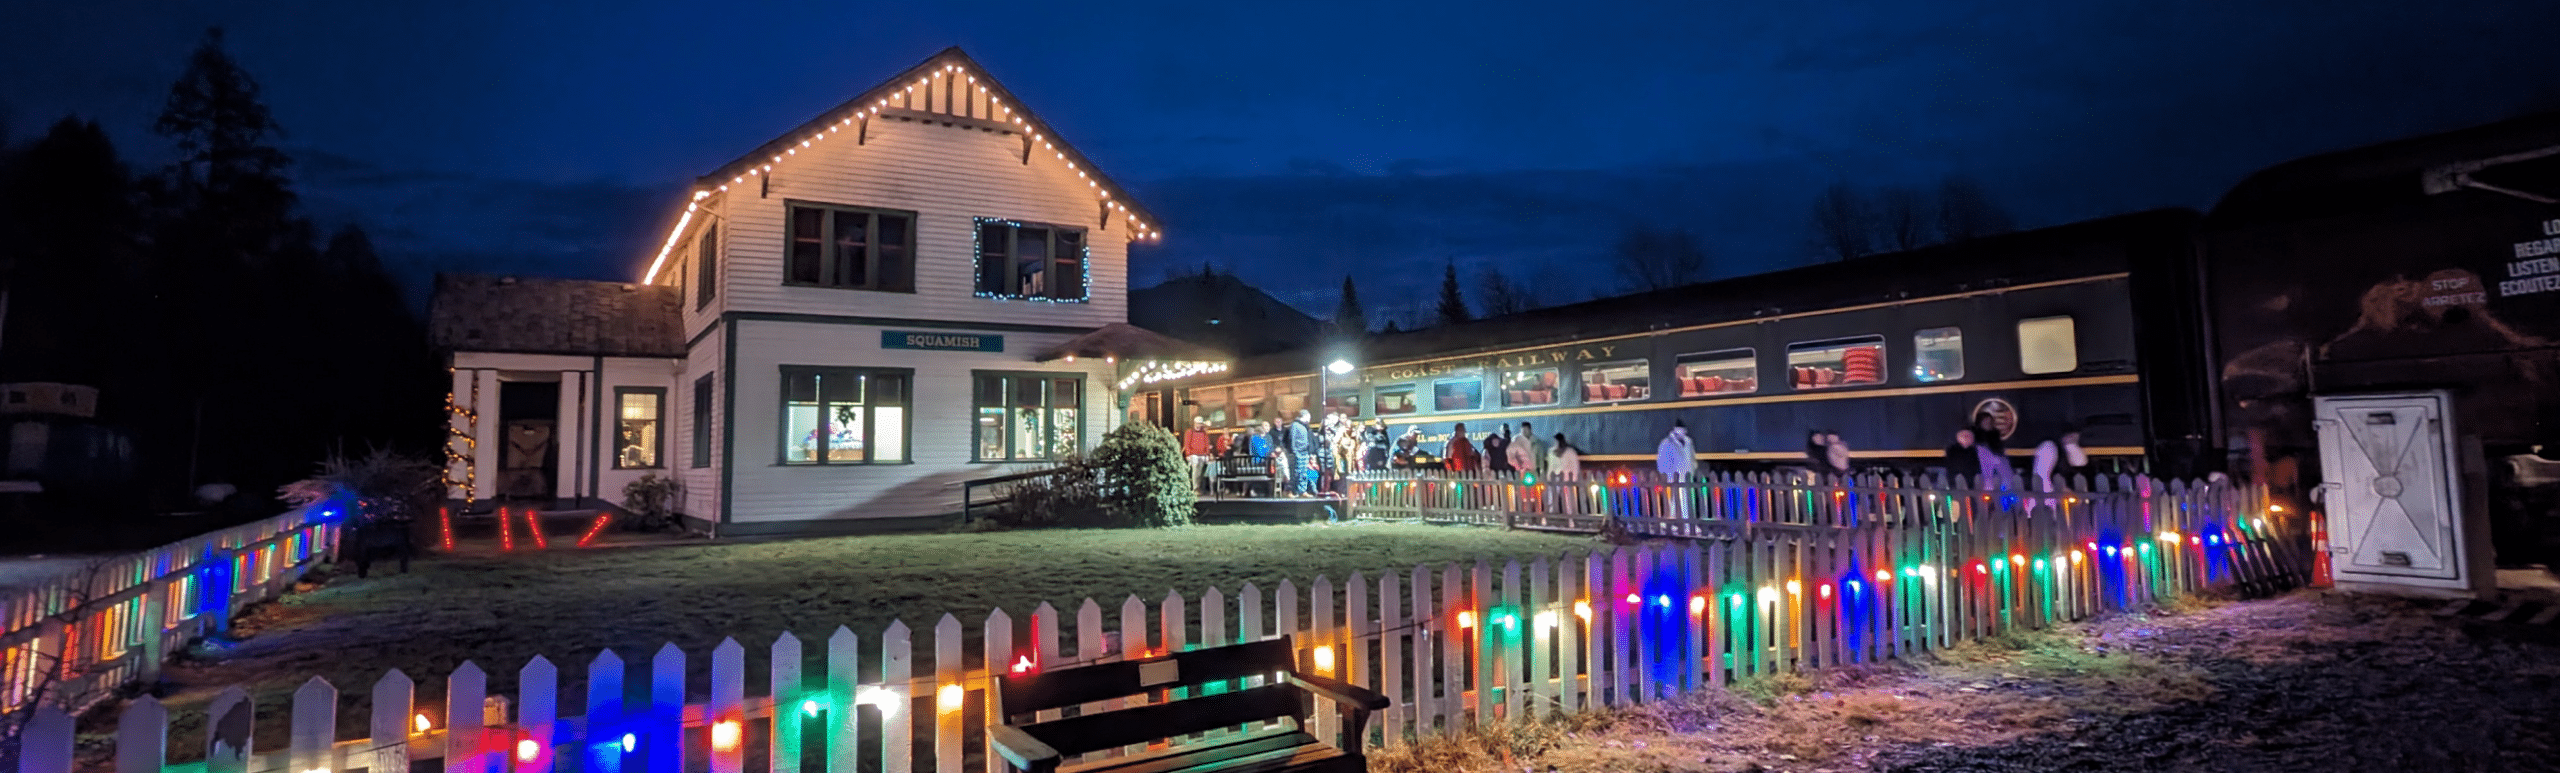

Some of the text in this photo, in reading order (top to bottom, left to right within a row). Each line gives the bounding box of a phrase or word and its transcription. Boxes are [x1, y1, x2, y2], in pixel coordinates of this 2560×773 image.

[2431, 277, 2469, 291] STOP
[906, 335, 979, 348] SQUAMISH
[1391, 364, 1455, 379] COAST
[1478, 346, 1615, 369] RAILWAY
